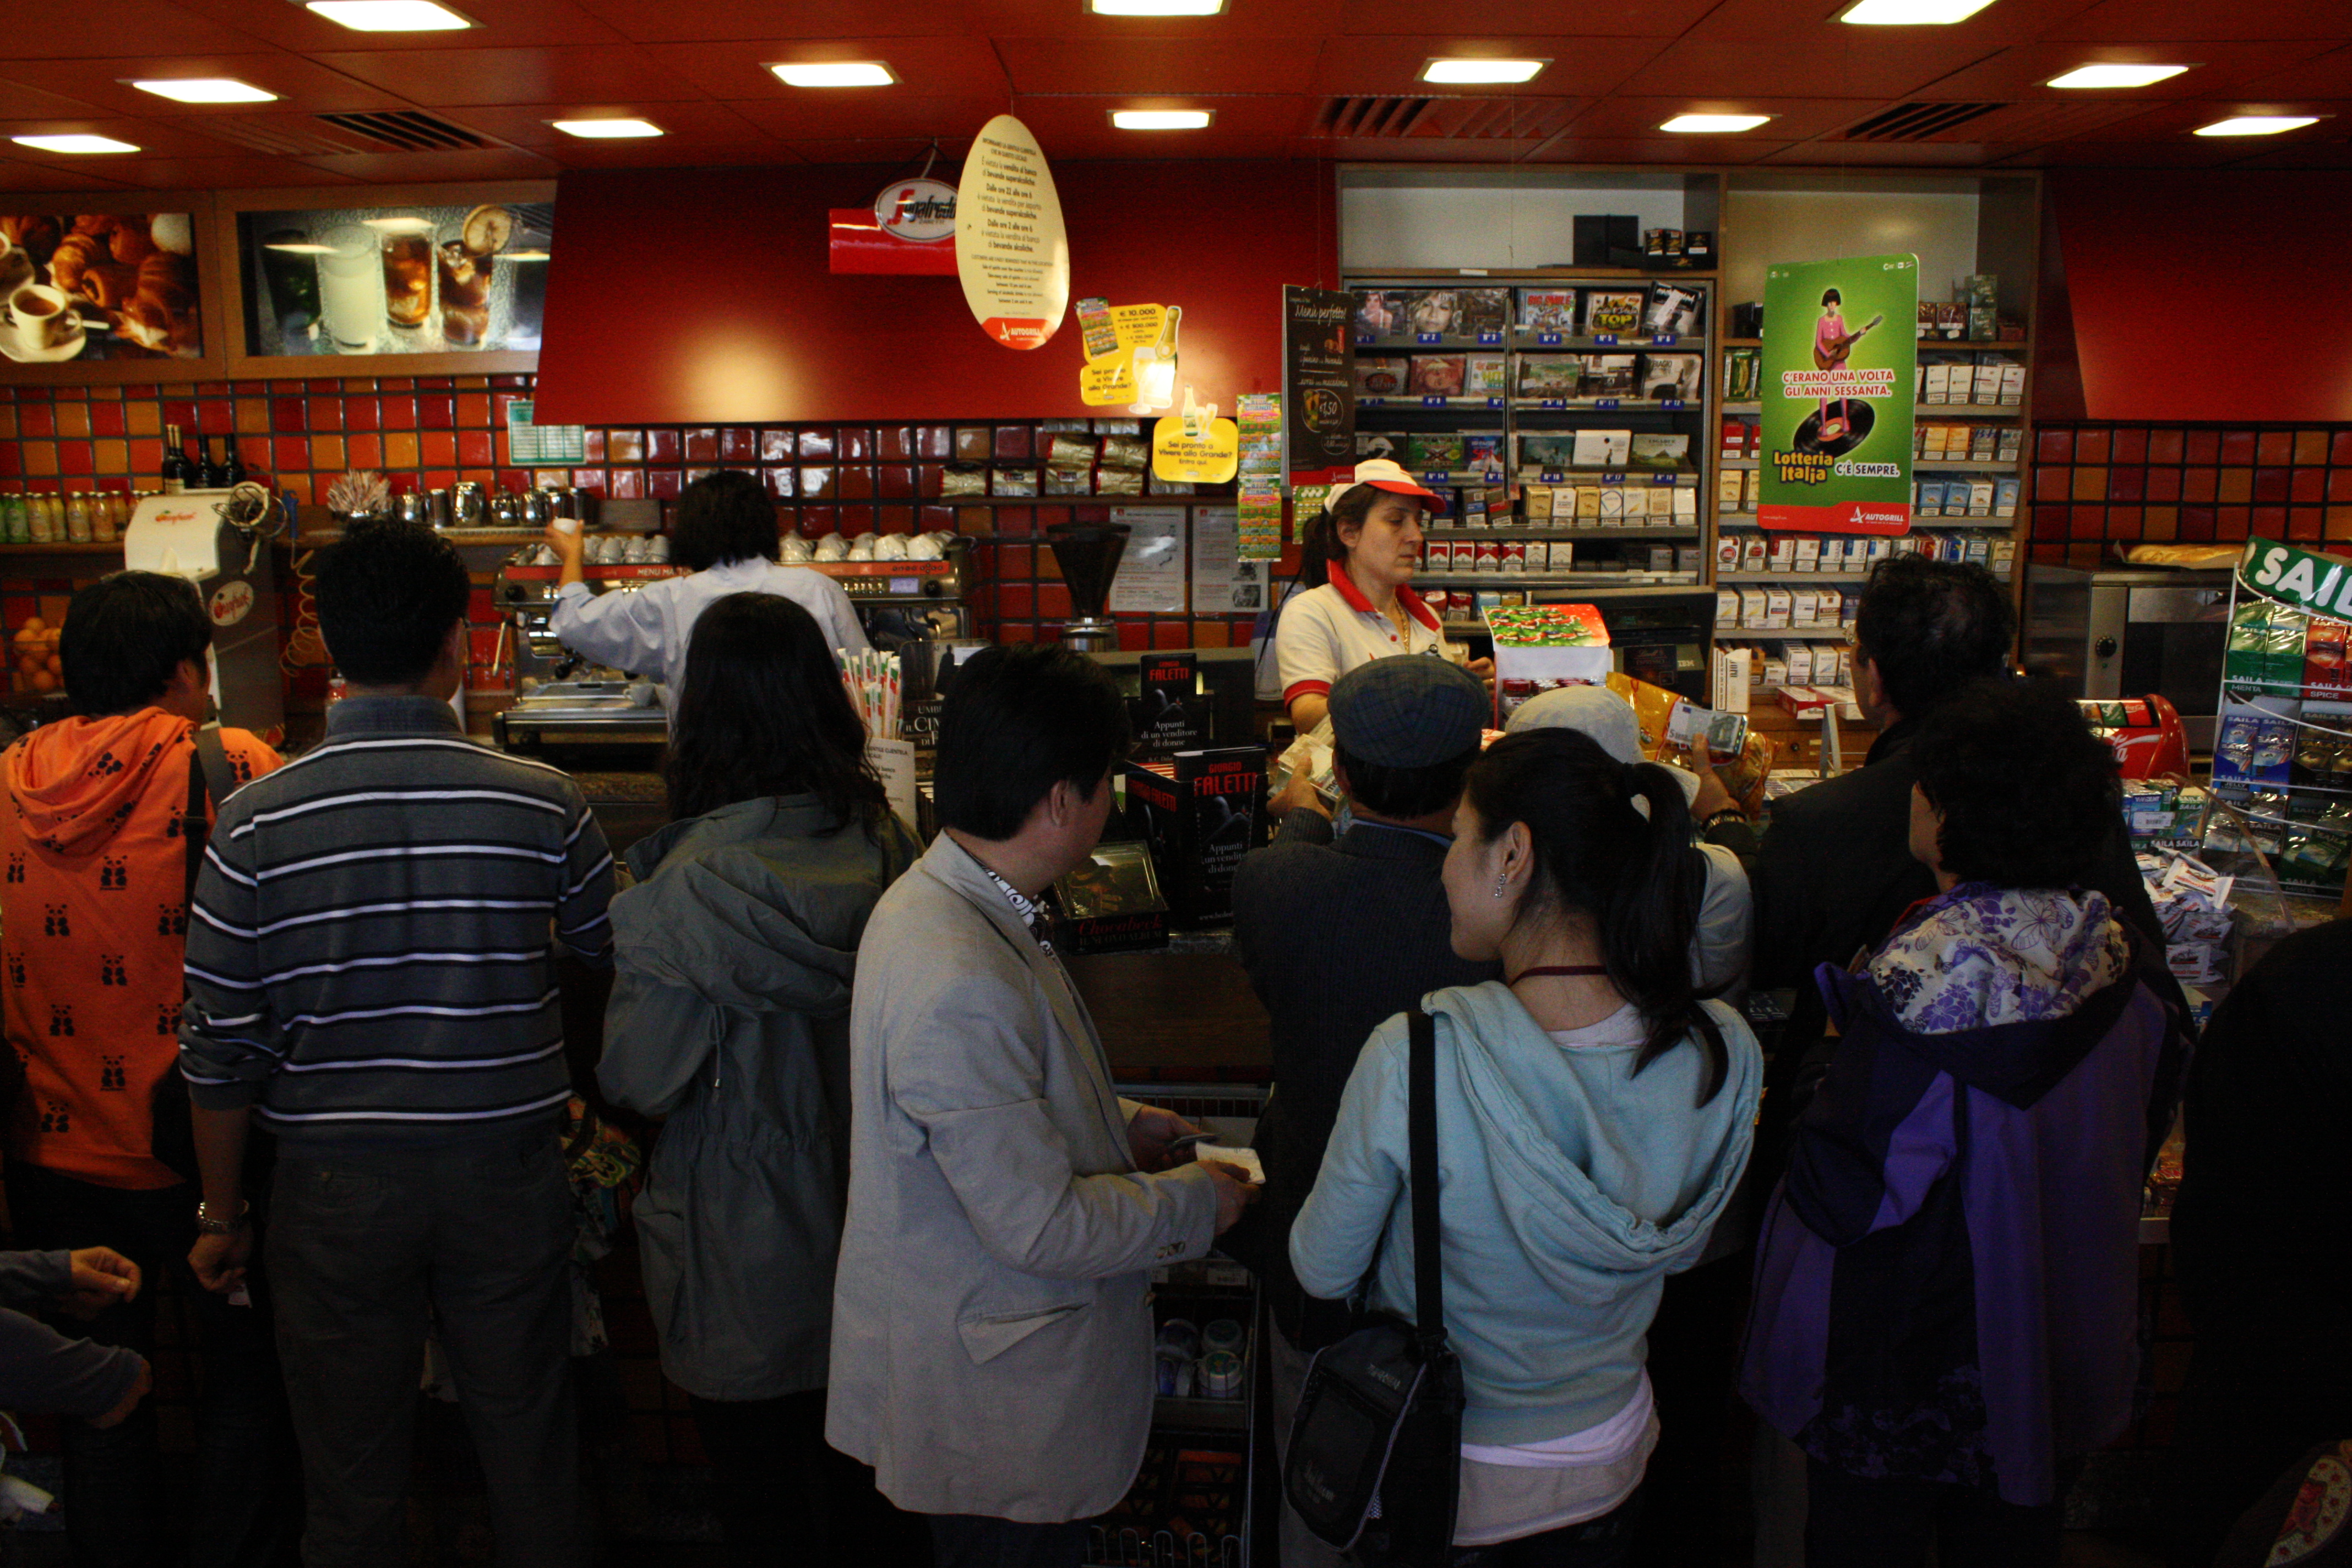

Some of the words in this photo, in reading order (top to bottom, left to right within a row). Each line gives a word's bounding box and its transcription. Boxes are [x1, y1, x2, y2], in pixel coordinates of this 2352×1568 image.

[987, 170, 1005, 179] bevande
[986, 183, 997, 192] Dalle
[987, 204, 1005, 214] bevande
[988, 219, 999, 228] Dalle
[993, 240, 1012, 250] bevande
[1544, 295, 1573, 306] SMILE
[1295, 303, 1317, 318] Menù
[1317, 303, 1347, 328] perfetto!
[1599, 314, 1634, 326] TOP
[1783, 372, 1829, 383] C'ERANO
[1831, 372, 1856, 382] UNA
[1859, 370, 1894, 382] VOLTA
[1785, 386, 1800, 397] GLI
[1804, 385, 1831, 396] ANNI
[1834, 384, 1891, 395] SESSANTA.
[1182, 442, 1206, 450] pronto
[1773, 451, 1834, 466] Lotteria
[1836, 461, 1852, 475] C'È
[1855, 465, 1899, 476] SEMPRE.
[1781, 466, 1826, 484] Italia
[1865, 513, 1904, 522] AUTOGRILL
[1833, 542, 1843, 562] DIANA
[1858, 541, 1869, 562] DIANA
[637, 568, 661, 576] MENU
[1148, 667, 1190, 682] FALETTI
[2233, 674, 2263, 684] SAILA
[2231, 684, 2262, 693] MENTA
[2311, 681, 2342, 690] SAILA
[2310, 691, 2339, 699] SPICE
[2228, 716, 2260, 724] SAILA
[906, 724, 914, 732] IL
[1154, 720, 1185, 732] Appunti
[1141, 731, 1149, 739] di
[1162, 728, 1198, 739] venditore
[1162, 738, 1186, 747] donne
[1208, 761, 1243, 774] GIORGIO
[1194, 771, 1258, 797] FALETTI
[1151, 788, 1178, 813] FALETTI
[1208, 841, 1243, 857] Appunti
[1205, 857, 1218, 866] un
[1208, 862, 1217, 873] di
